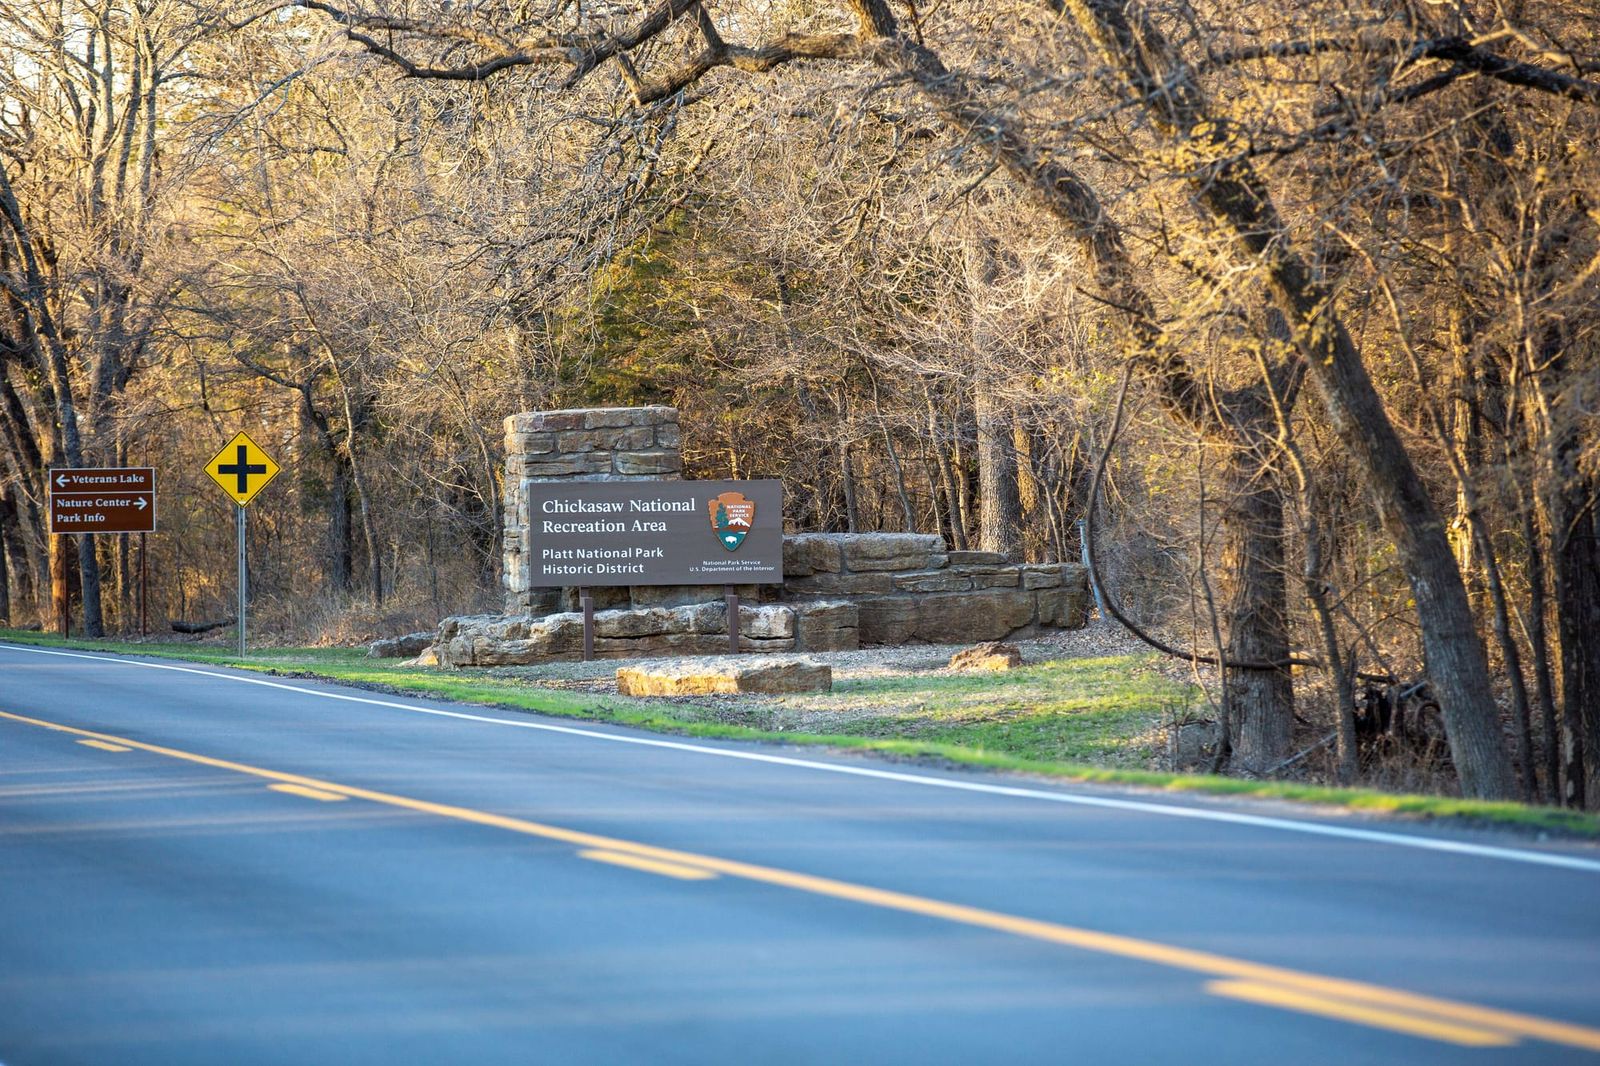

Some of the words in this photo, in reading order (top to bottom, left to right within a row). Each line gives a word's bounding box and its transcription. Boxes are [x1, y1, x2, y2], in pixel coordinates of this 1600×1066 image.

[72, 475, 117, 483] Veterans
[120, 474, 144, 483] Lake
[57, 499, 92, 507] Nature
[543, 500, 624, 513] Chickasaw
[630, 498, 696, 512] National
[57, 514, 81, 522] Park
[84, 513, 105, 522] Info
[543, 520, 625, 532] Recreation
[632, 519, 666, 531] Area
[543, 548, 572, 559] Platt
[577, 548, 632, 558] National
[636, 548, 663, 558] Park
[543, 564, 593, 574] Historic
[597, 563, 644, 573] District
